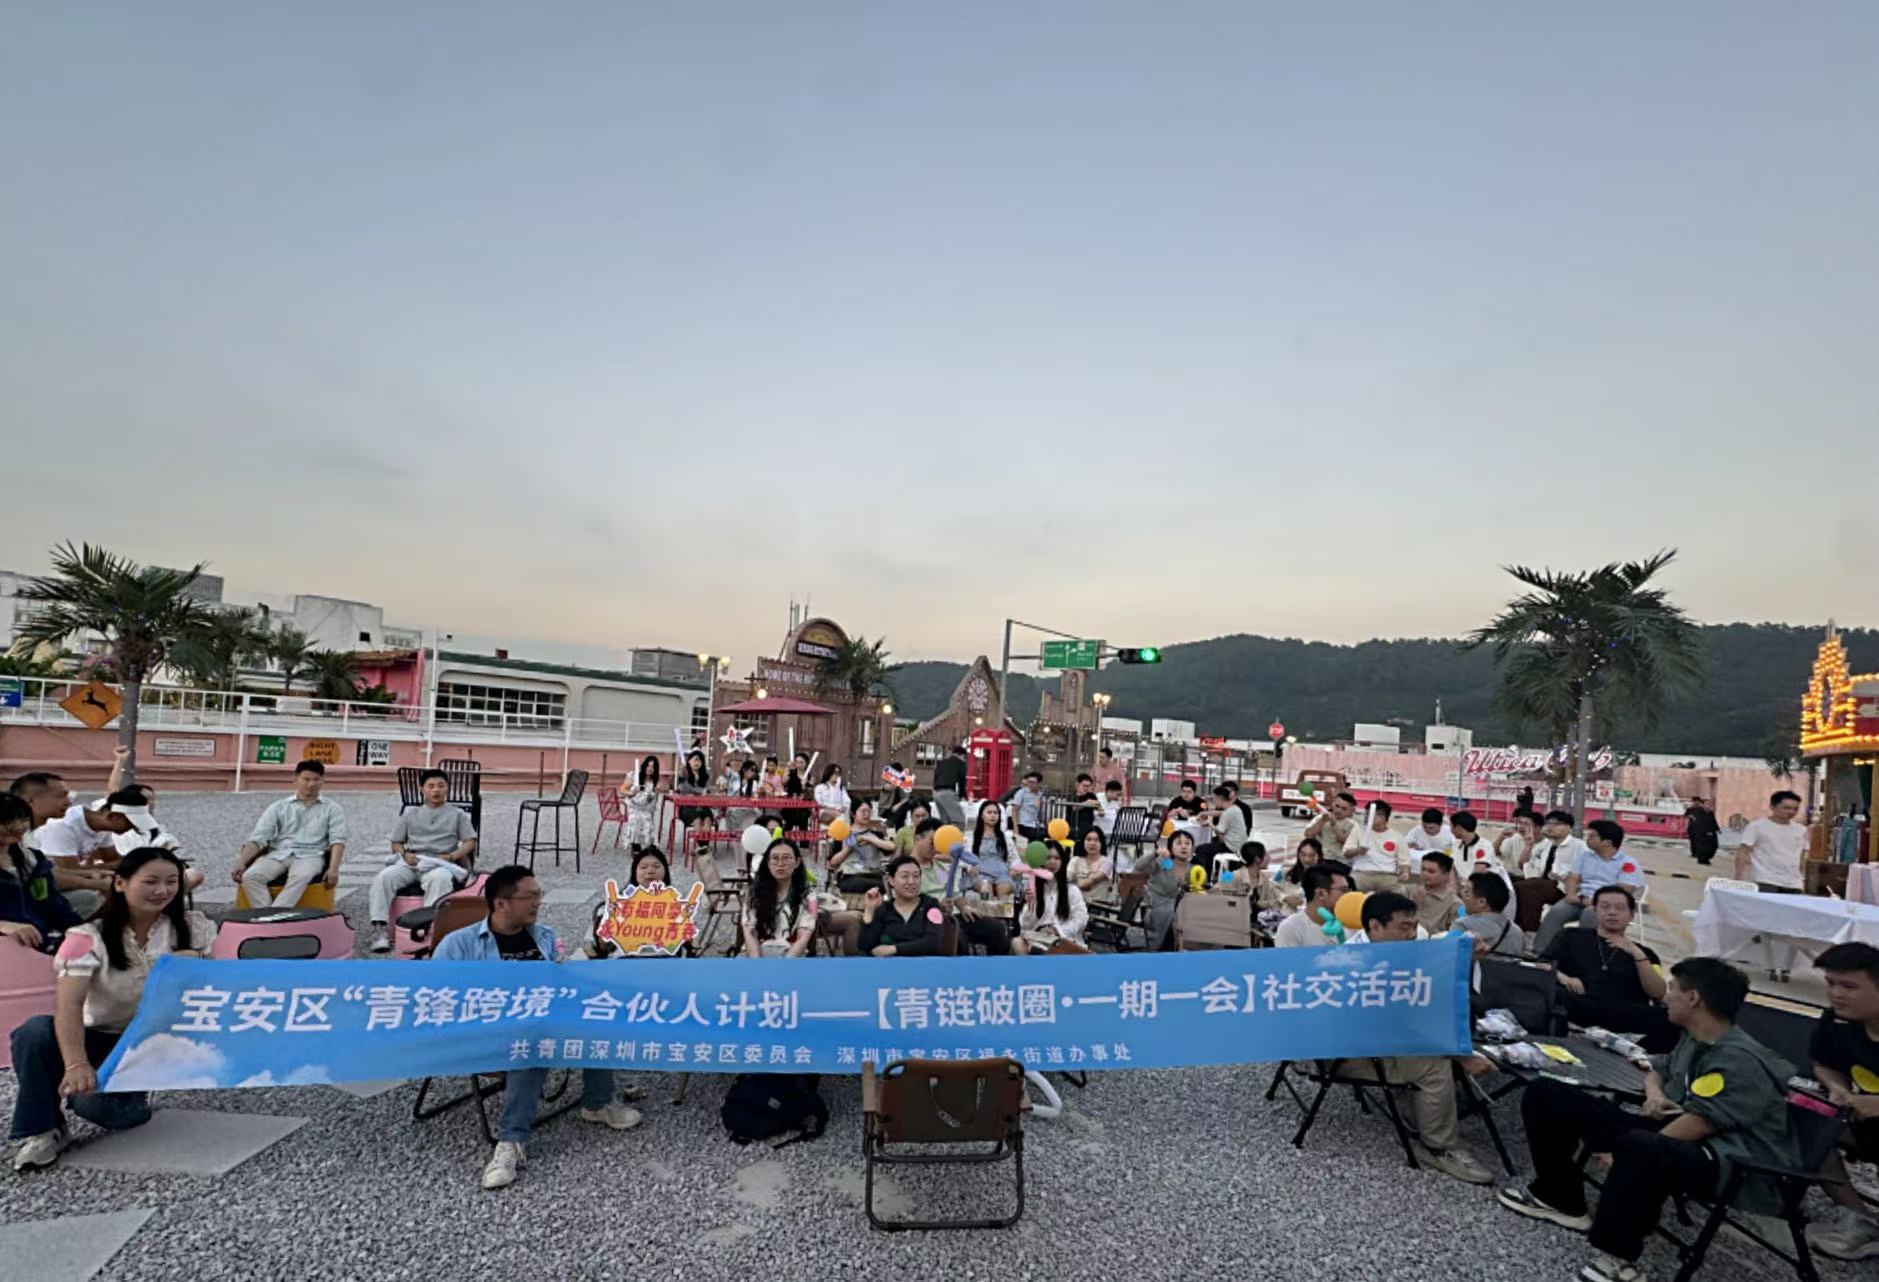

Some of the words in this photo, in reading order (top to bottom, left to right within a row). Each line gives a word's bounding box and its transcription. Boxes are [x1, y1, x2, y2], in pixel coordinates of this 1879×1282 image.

[370, 742, 388, 751] ONE
[369, 751, 388, 759] WAY
[509, 1038, 813, 1064] 共青团深圳市宝安区委员会
